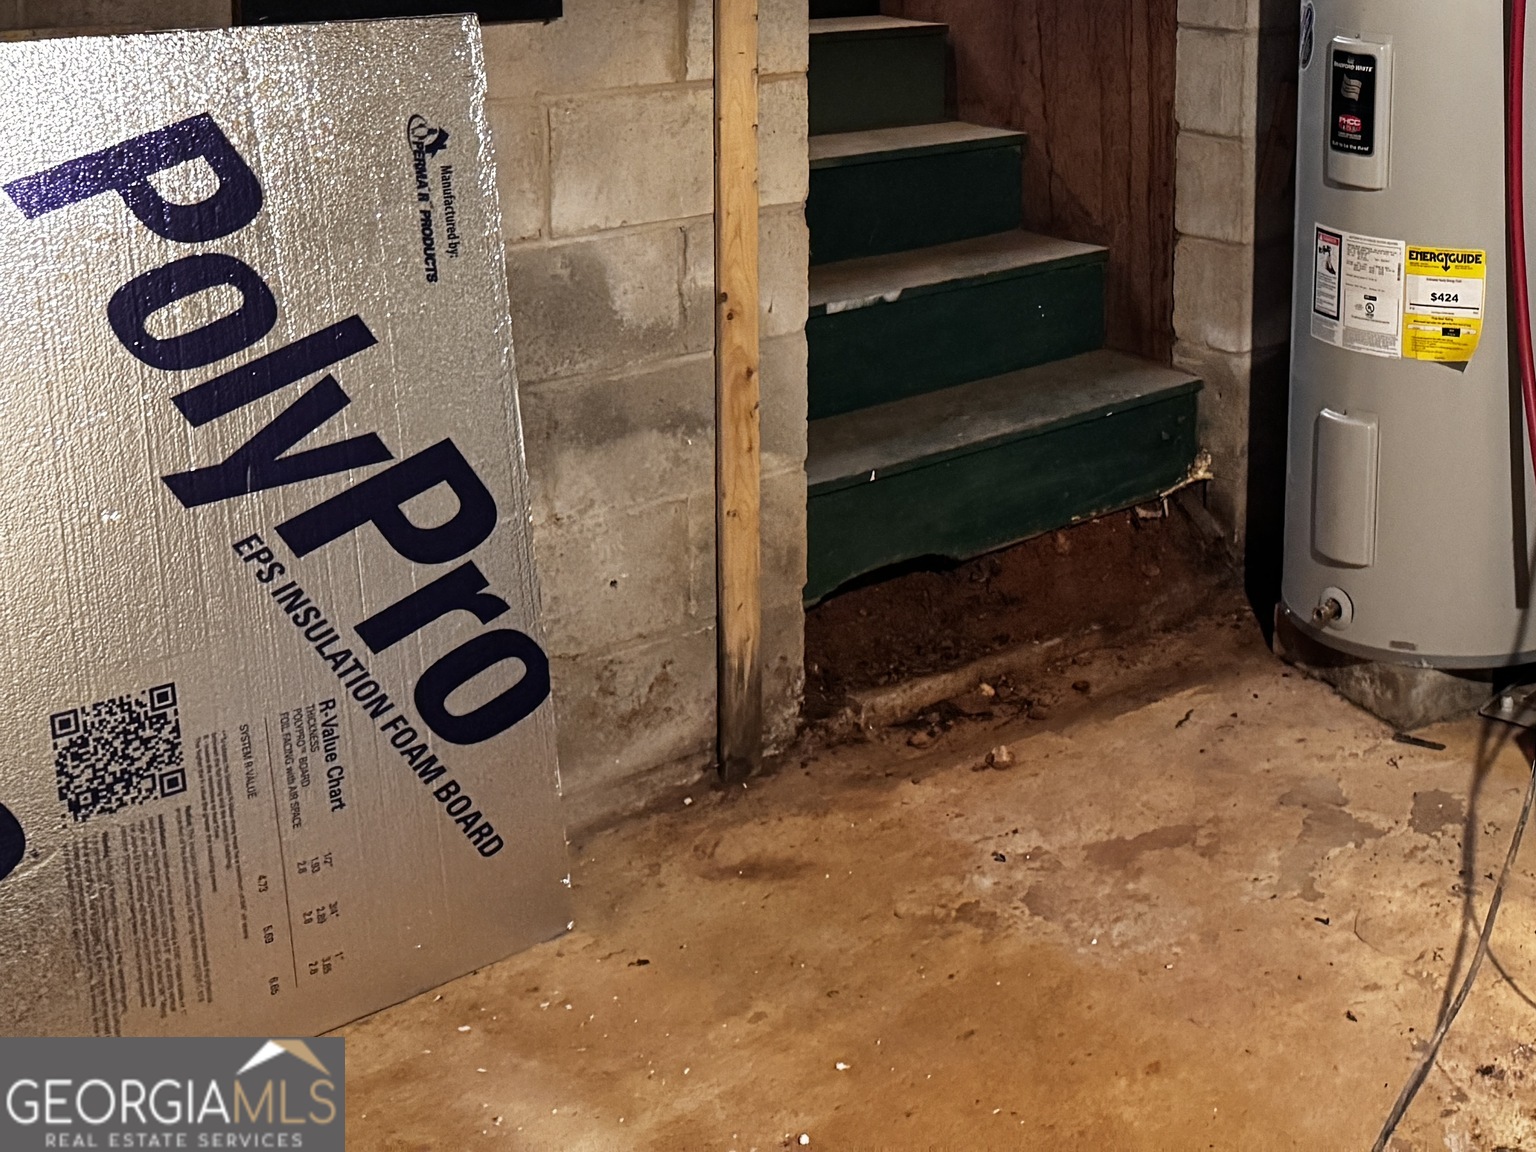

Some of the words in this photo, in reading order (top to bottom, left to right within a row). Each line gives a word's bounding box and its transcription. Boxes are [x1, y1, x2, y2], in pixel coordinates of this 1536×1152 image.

[440, 165, 460, 240] Manufactured
[420, 209, 438, 283] PRODUCTS
[1430, 292, 1459, 303] $424
[3, 112, 551, 745] PolyPro
[231, 532, 286, 585] EPS
[271, 580, 395, 720] INSULATION
[380, 715, 447, 785] FOAM
[432, 778, 504, 859] BOARD
[280, 711, 290, 732] FOIL
[306, 703, 320, 753] THICKNESS
[319, 698, 340, 762] R-Value
[239, 724, 253, 759] SYSTEM
[283, 733, 294, 767] FACING
[244, 758, 257, 799] R-VALUE
[286, 766, 296, 786] with
[299, 756, 310, 788] BOARD
[327, 765, 346, 812] Chart
[289, 785, 299, 802] AIR
[290, 801, 302, 829] SPACE
[257, 875, 268, 893] 4.73
